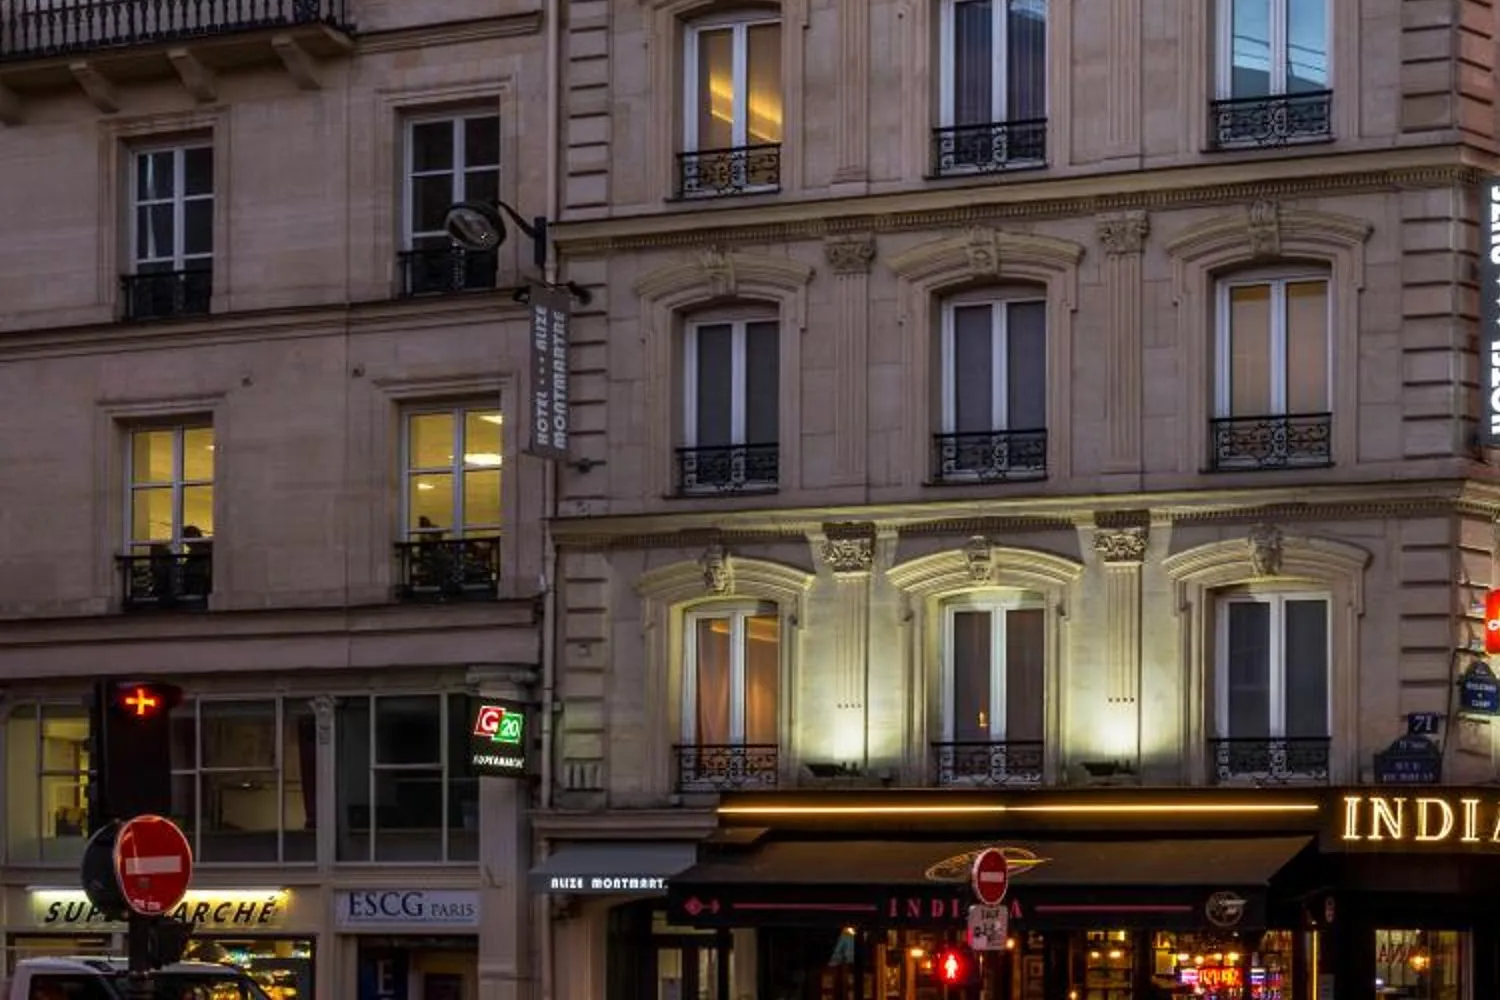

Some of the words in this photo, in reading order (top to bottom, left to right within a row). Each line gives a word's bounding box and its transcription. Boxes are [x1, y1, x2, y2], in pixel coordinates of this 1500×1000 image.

[535, 305, 548, 350] ALIZE
[553, 311, 568, 450] MONTMARTRE
[537, 391, 549, 446] HOTEL
[1414, 715, 1433, 731] 71
[551, 877, 583, 889] ALIZE
[591, 877, 669, 889] MONTMART
[45, 895, 277, 923] SUPARCHÉ
[350, 891, 424, 917] ESCG
[431, 903, 475, 917] PARIS
[889, 898, 1022, 918] INDIA
